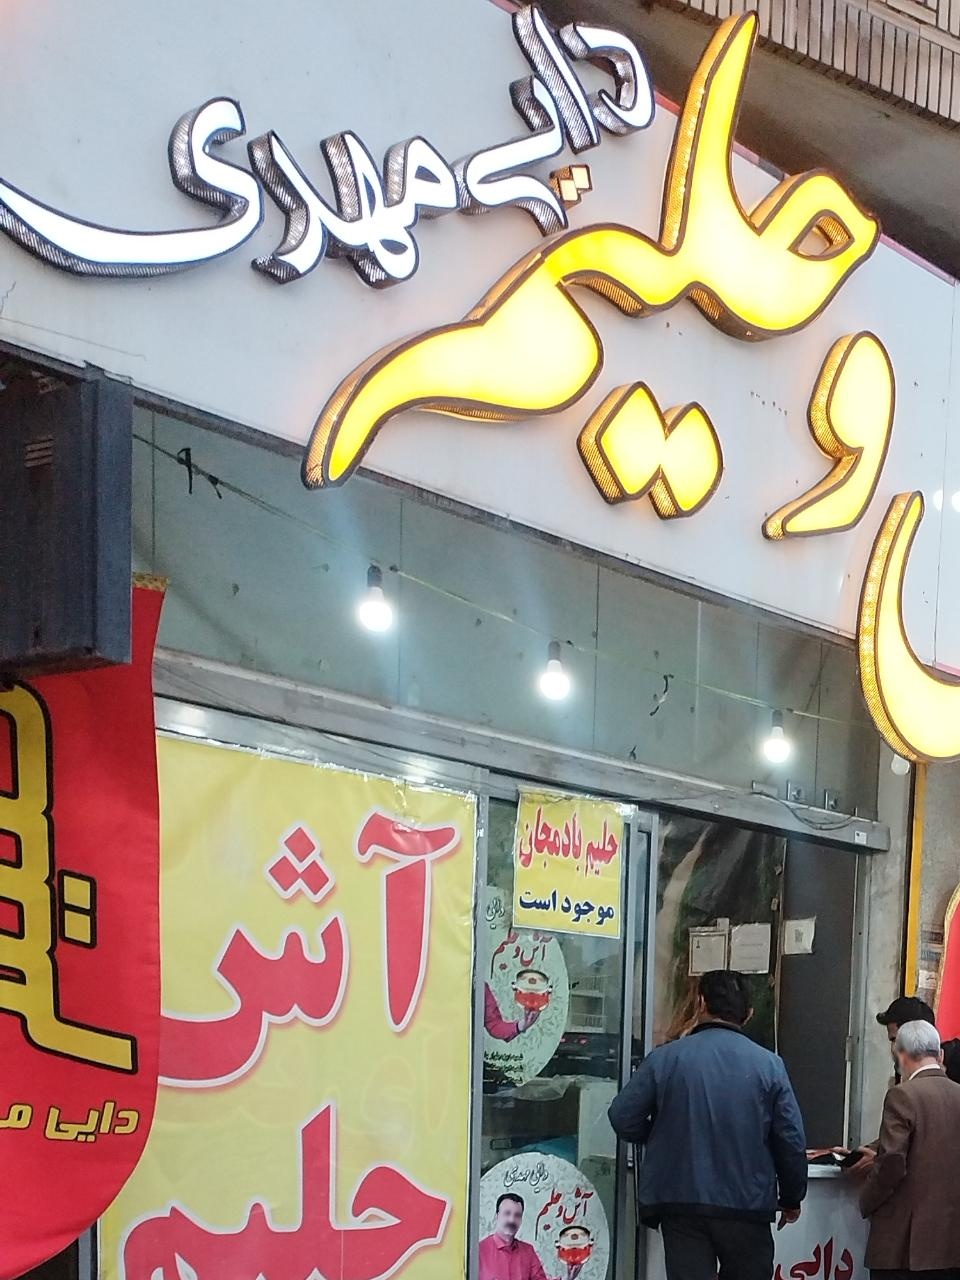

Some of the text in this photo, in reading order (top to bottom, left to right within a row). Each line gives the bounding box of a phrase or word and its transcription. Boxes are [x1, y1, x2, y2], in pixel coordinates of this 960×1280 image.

[0, 95, 457, 288] مهدی
[301, 10, 881, 520] حلیم
[762, 330, 896, 541] و
[518, 806, 619, 876] حلیم بادمجان
[518, 889, 616, 926] موجود است
[157, 812, 457, 1083] آش
[44, 1101, 140, 1143] دایی
[534, 1187, 563, 1242] حلیم
[562, 1187, 594, 1225] آش
